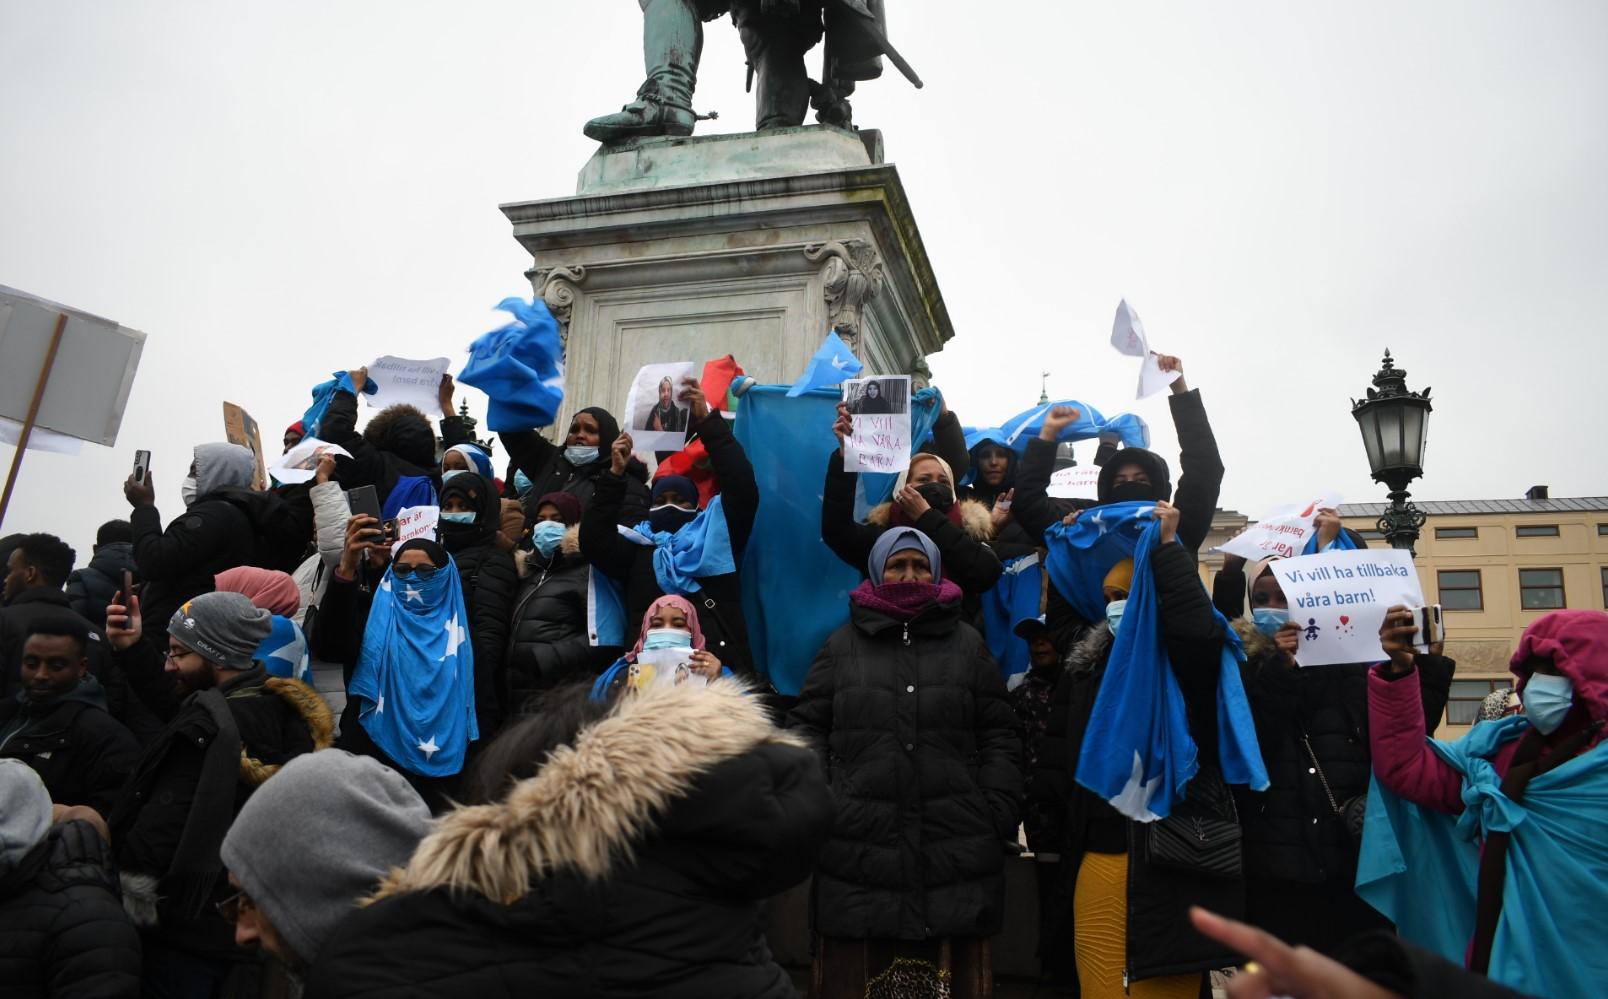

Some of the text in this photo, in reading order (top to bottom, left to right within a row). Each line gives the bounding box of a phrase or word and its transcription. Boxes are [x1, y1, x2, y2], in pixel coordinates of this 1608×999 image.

[400, 515, 412, 526] ar
[1284, 562, 1409, 584] Vi vill ha tillbaka
[1296, 587, 1376, 609] våra barn!
[196, 639, 221, 657] CRAFT
